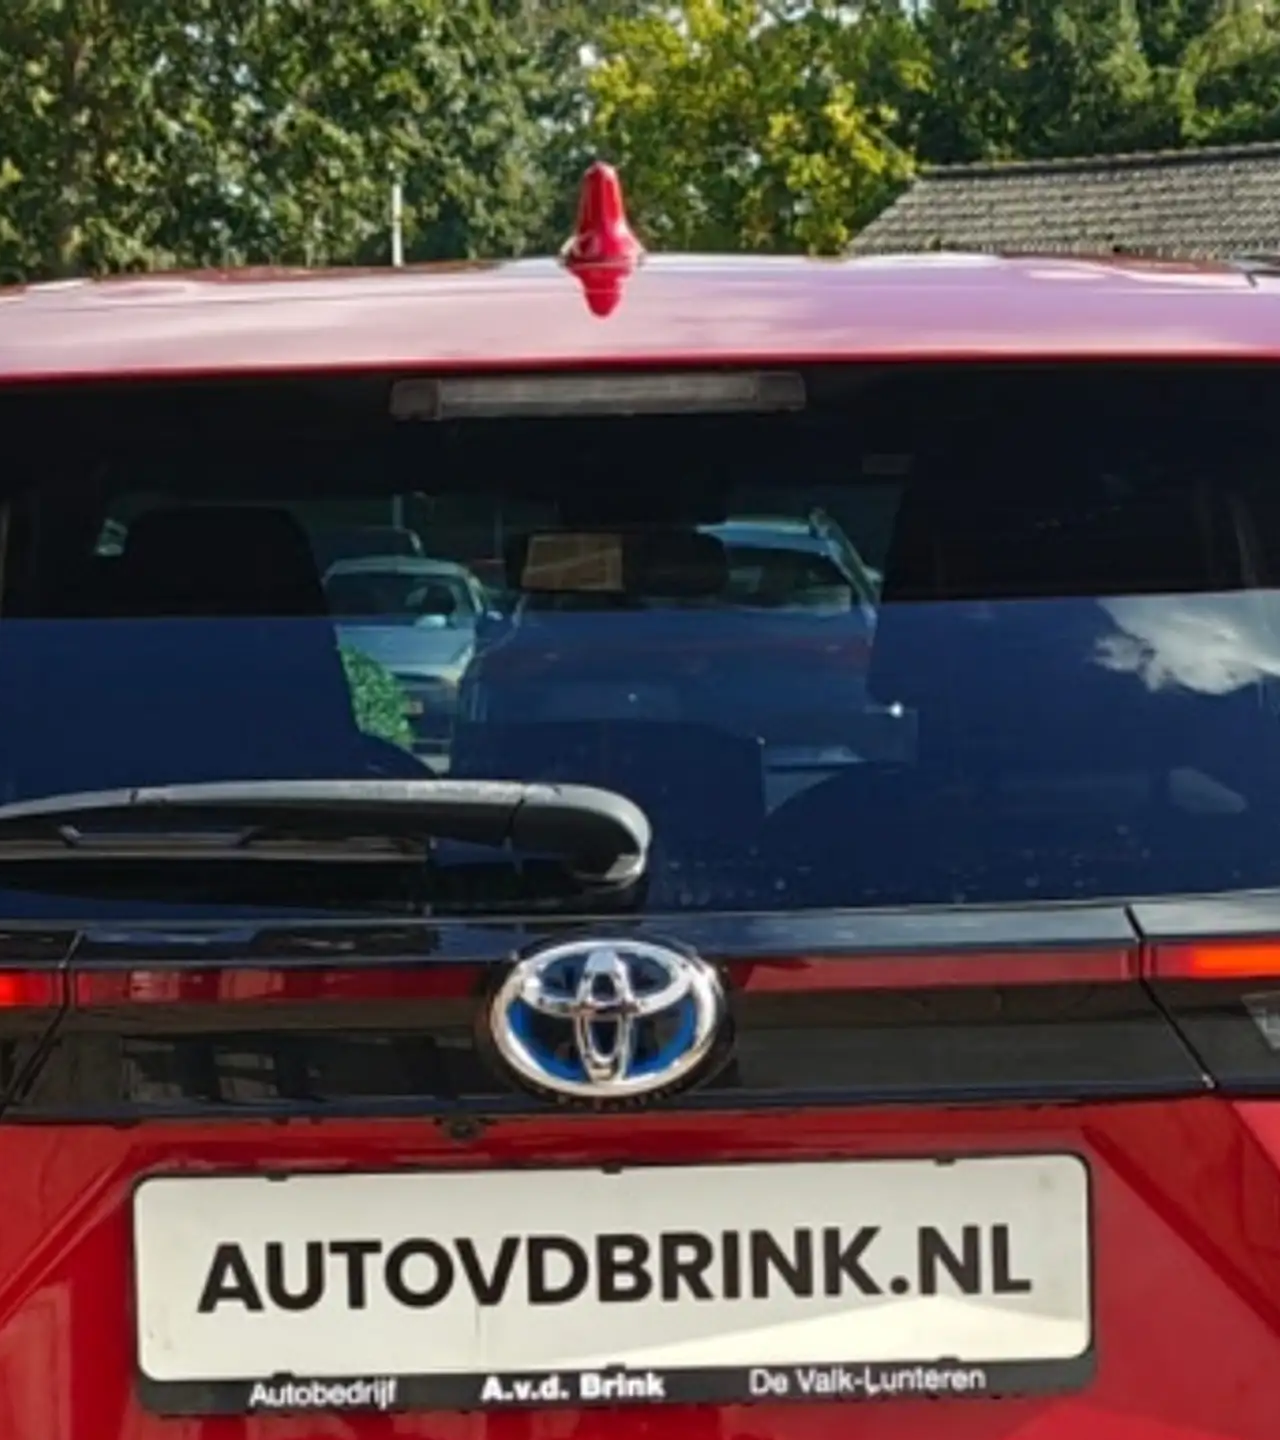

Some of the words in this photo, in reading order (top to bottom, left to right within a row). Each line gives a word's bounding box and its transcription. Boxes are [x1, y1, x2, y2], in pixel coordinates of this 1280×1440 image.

[198, 1224, 1031, 1312] AUTOVDBRINK.NL
[248, 1379, 397, 1409] Autobedrijf
[480, 1375, 570, 1401] A.v.d.
[578, 1371, 666, 1400] Brink
[748, 1367, 789, 1395] De
[795, 1364, 987, 1396] Valk-Lunteren
